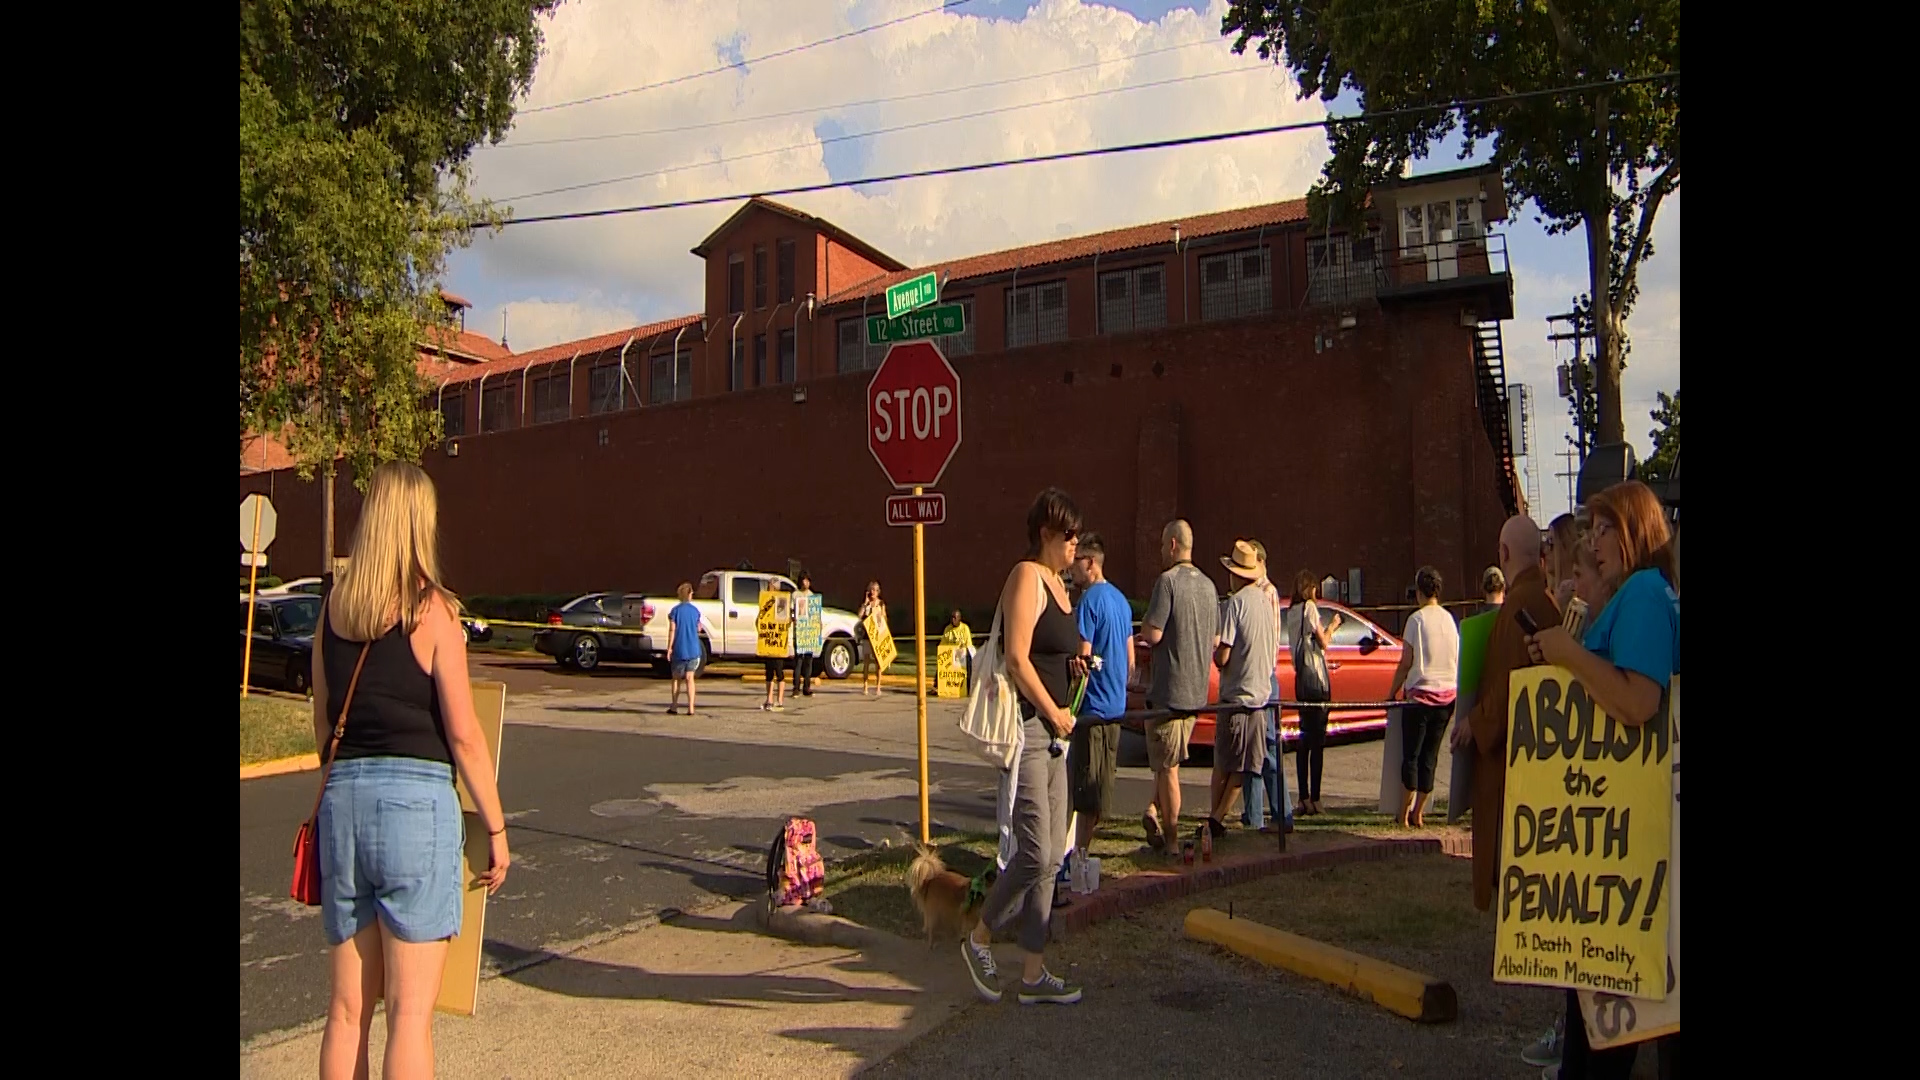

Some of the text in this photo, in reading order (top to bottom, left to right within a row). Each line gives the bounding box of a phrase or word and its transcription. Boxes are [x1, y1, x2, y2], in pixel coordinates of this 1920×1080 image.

[893, 287, 918, 312] Avenue
[901, 312, 939, 337] Street
[874, 385, 952, 442] STOP
[892, 501, 939, 519] ALL WAY
[1563, 764, 1609, 798] the
[1514, 804, 1630, 860] DEATH
[1503, 859, 1667, 931] PENALTY!
[1532, 933, 1572, 953] Death
[1581, 937, 1635, 974] Penalty
[1498, 954, 1558, 979] Abolition
[1564, 959, 1643, 993] Movement
